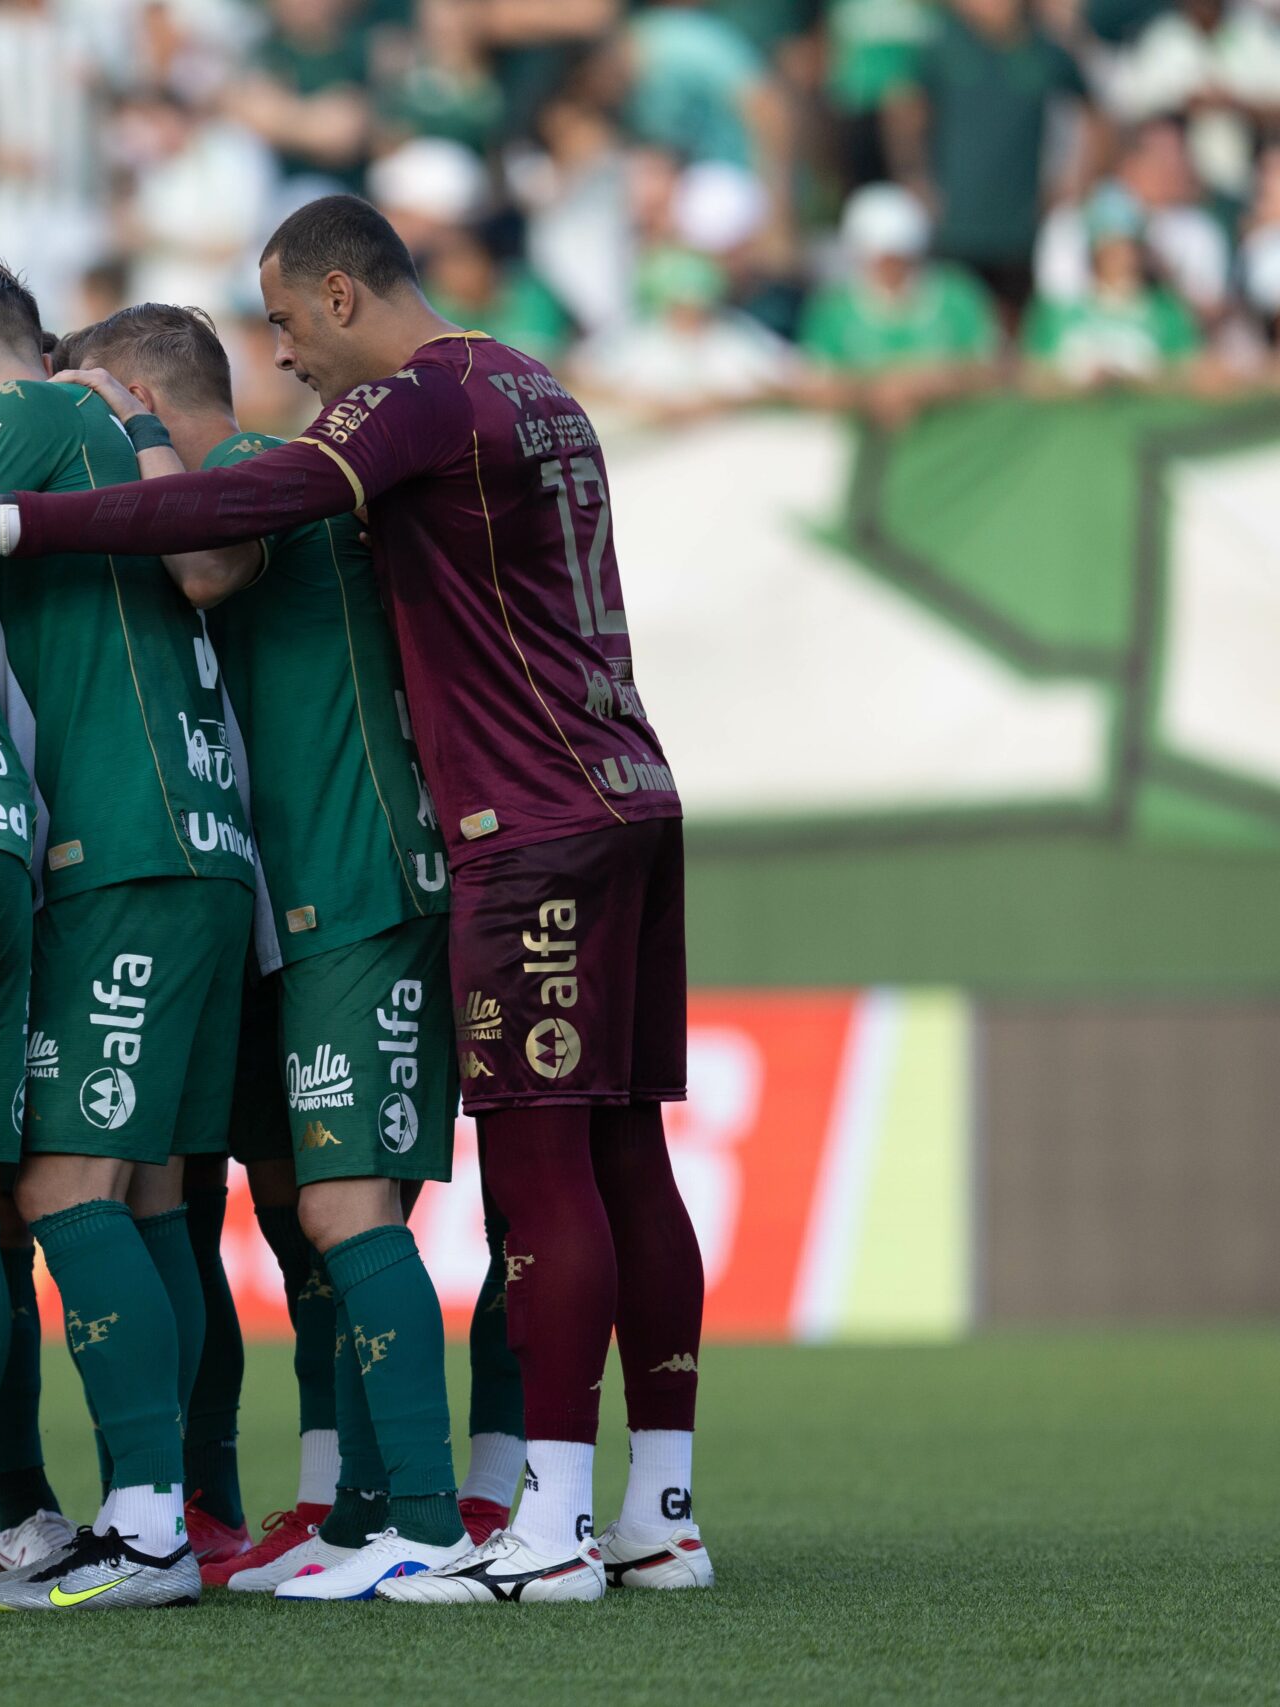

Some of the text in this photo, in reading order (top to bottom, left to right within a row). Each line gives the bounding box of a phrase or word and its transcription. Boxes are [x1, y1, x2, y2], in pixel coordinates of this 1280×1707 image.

[540, 456, 629, 638] 12
[522, 898, 578, 1008] alfa
[89, 953, 153, 1065] alfa
[376, 979, 422, 1089] alfa
[471, 1029, 502, 1040] MALTE
[30, 1067, 60, 1077] MALTE
[286, 1043, 352, 1109] Dalla
[298, 1093, 354, 1112] PURO MALTE
